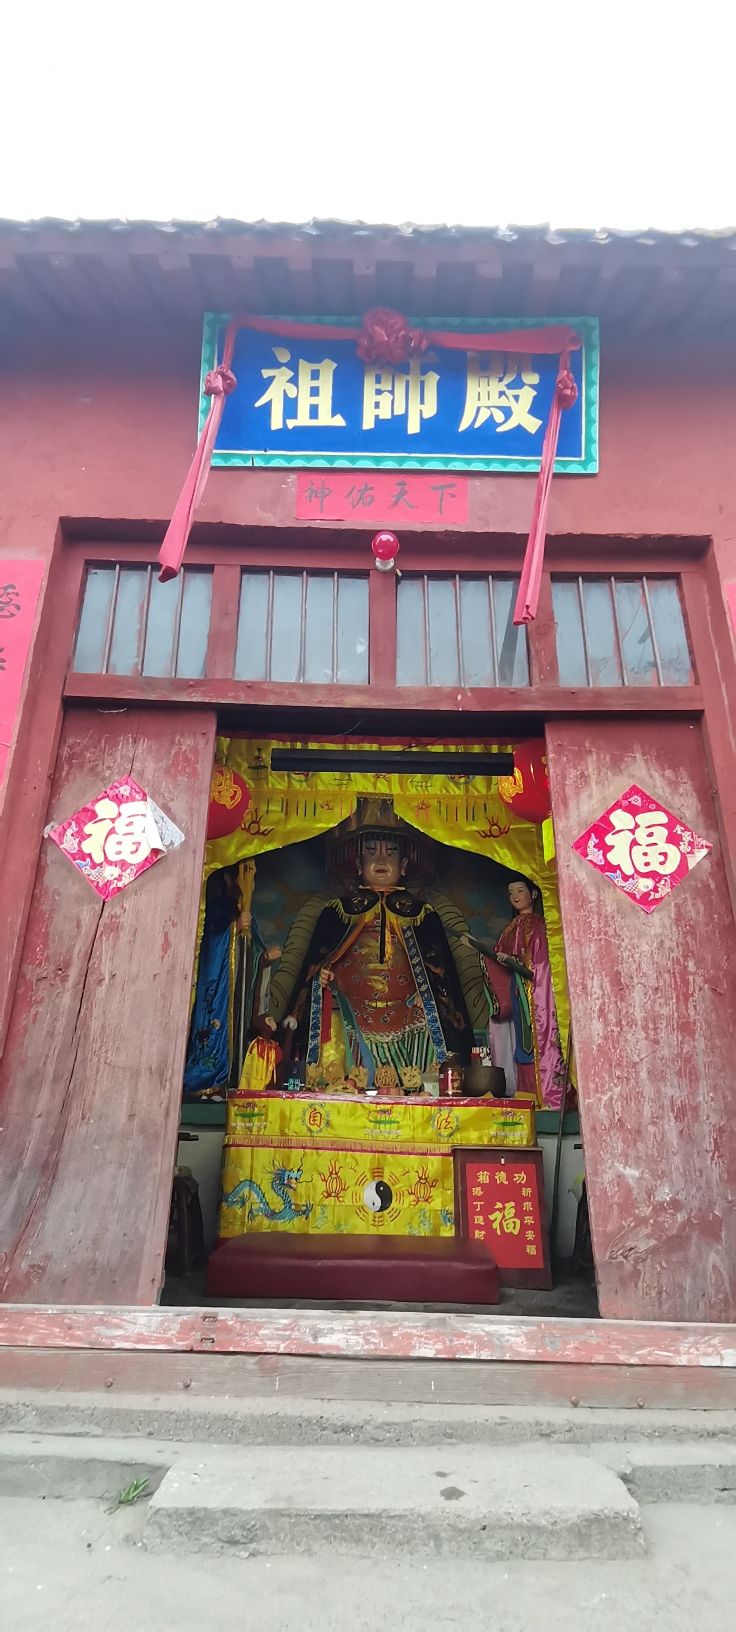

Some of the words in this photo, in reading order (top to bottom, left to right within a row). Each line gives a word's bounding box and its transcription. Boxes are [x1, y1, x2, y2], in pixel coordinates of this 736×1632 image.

[254, 347, 543, 434] 祖師殿
[304, 480, 457, 516] 神佑天下
[604, 809, 681, 875] 福
[488, 1201, 520, 1236] 福
